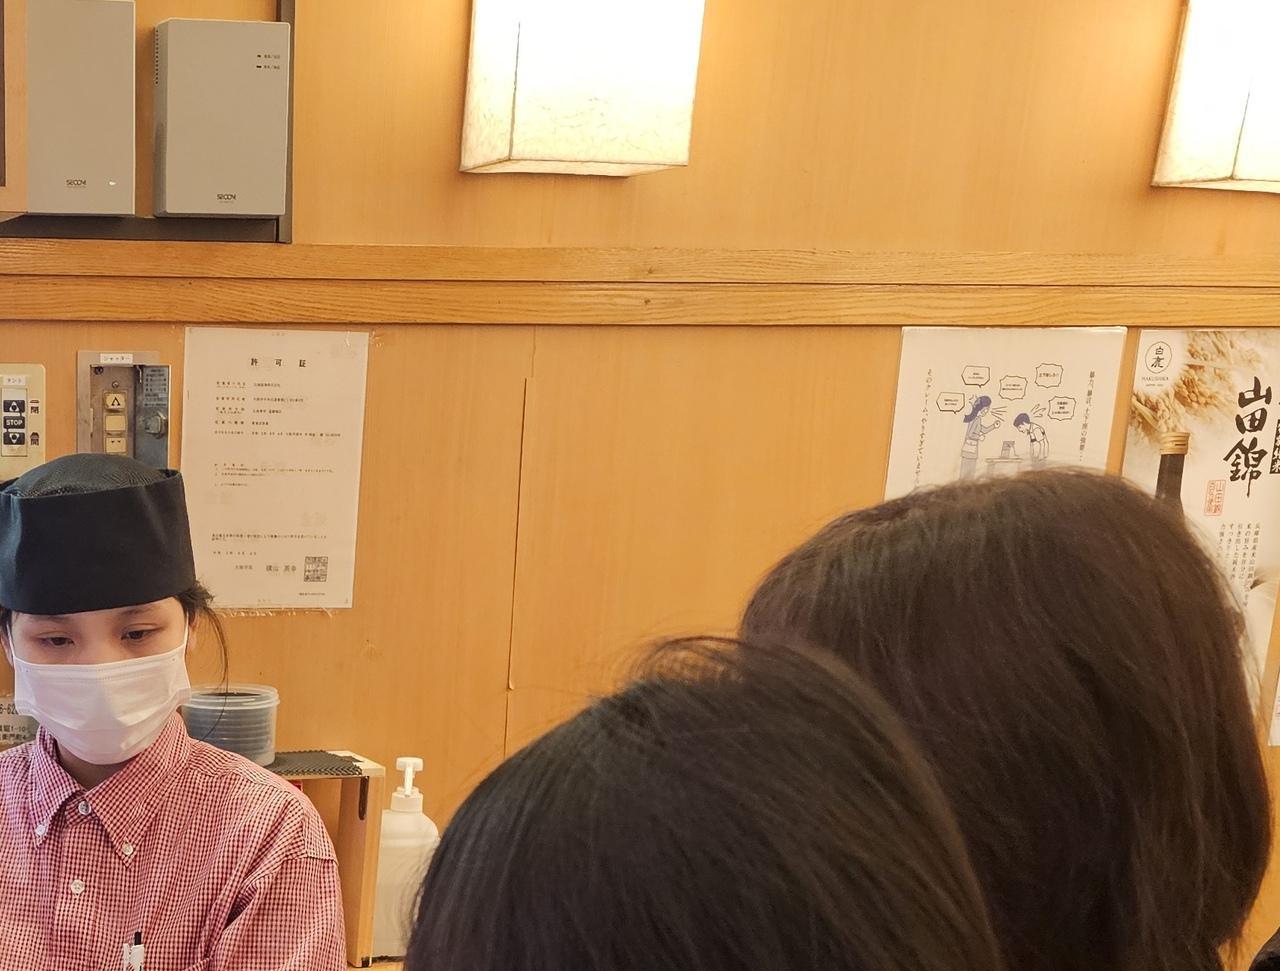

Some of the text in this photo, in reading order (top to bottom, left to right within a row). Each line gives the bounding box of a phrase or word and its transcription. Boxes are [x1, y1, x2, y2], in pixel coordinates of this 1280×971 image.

[251, 357, 307, 368] 許可証
[5, 419, 24, 427] STOP
[1223, 376, 1272, 499] 山田錦
